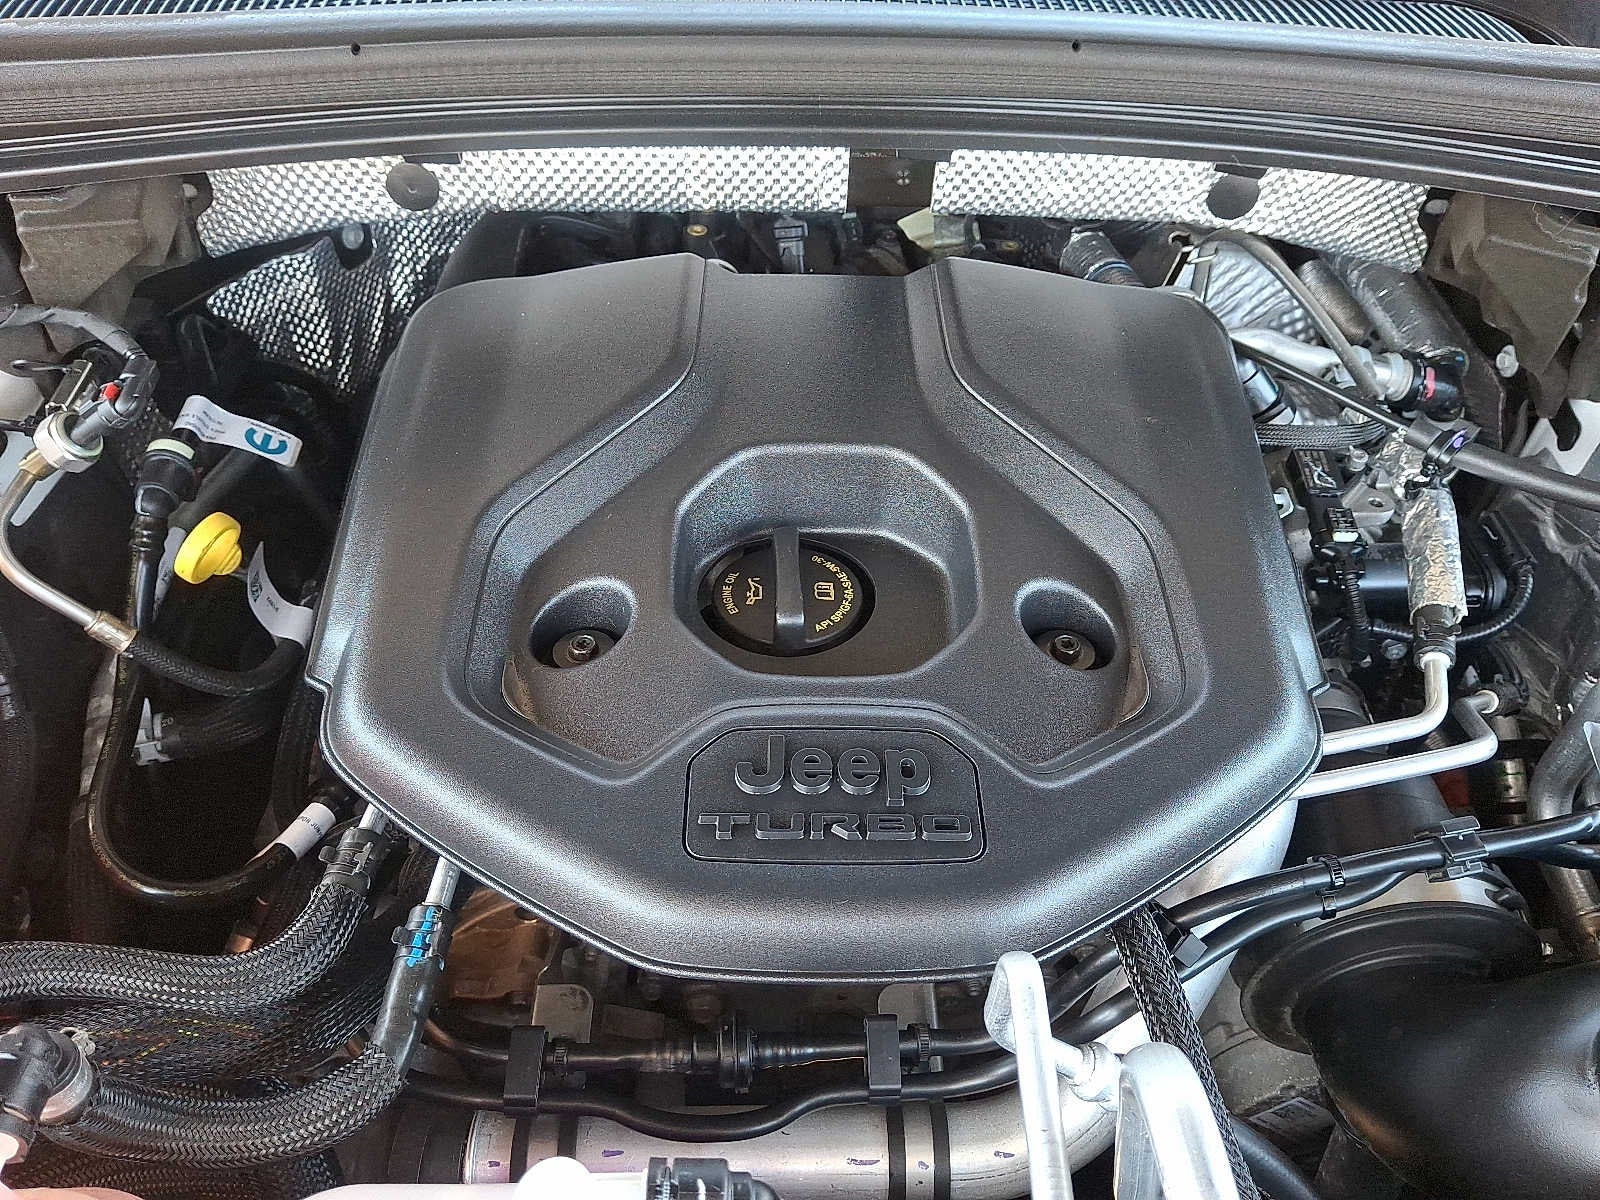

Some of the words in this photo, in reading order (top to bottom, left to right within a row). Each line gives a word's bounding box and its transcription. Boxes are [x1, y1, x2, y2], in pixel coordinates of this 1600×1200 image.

[725, 571, 740, 584] OIL
[721, 585, 739, 615] ENGINE
[815, 620, 834, 632] API
[734, 734, 932, 807] Jeep
[697, 813, 973, 841] TURBO
